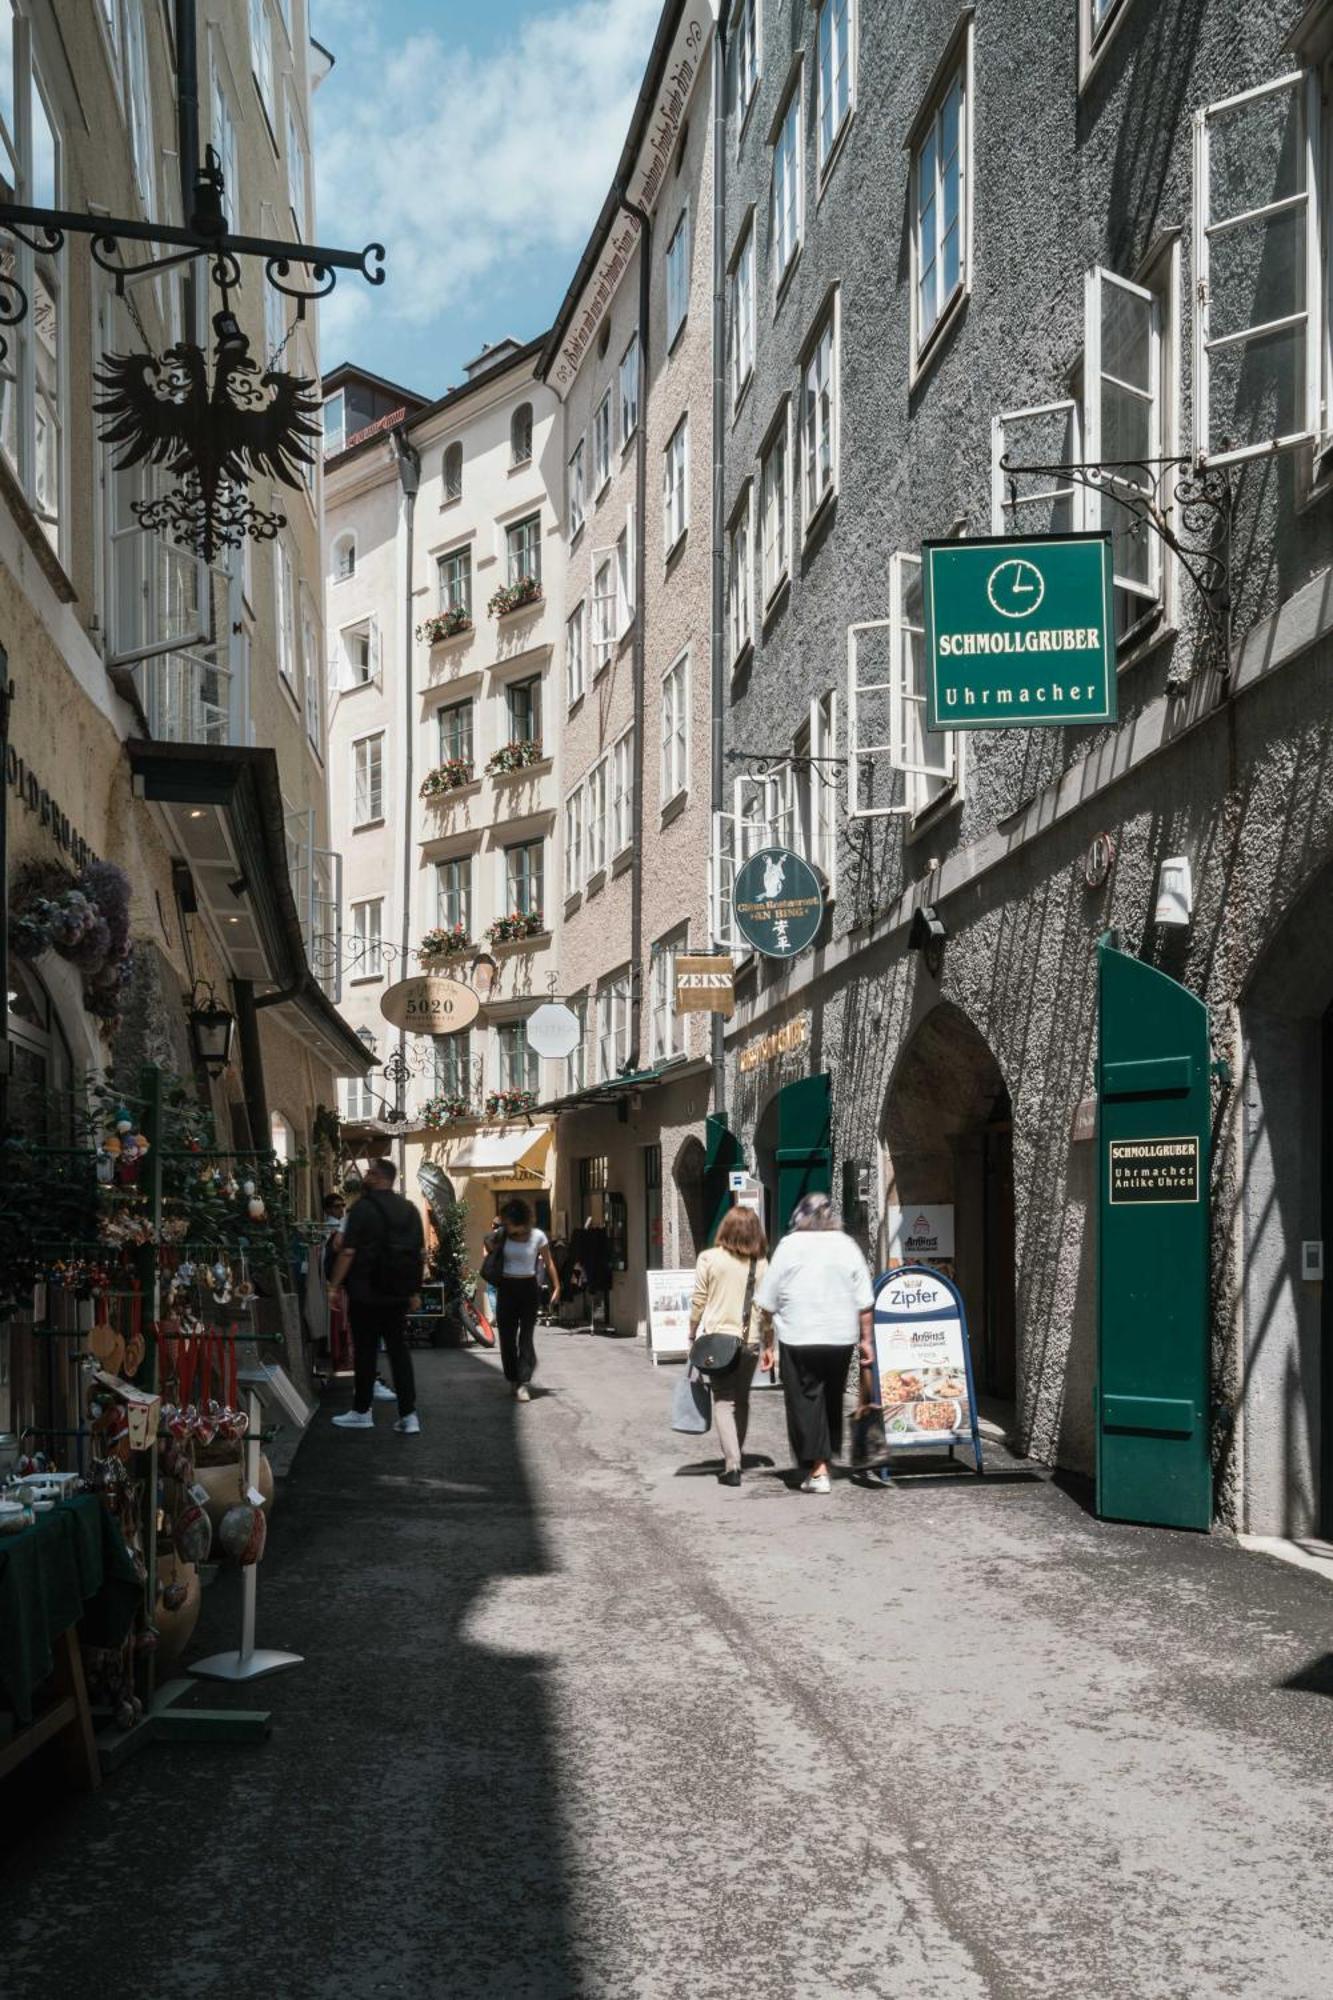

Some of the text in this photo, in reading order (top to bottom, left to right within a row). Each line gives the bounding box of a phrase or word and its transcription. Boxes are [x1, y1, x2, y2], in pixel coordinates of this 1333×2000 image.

[939, 628, 1101, 656] SCHMOLLGRUBER
[946, 683, 1096, 705] Uhrmacher
[677, 974, 733, 989] ZEISS
[405, 999, 454, 1014] 5020
[1112, 1143, 1196, 1158] SCHMOLLGRUBER
[1115, 1166, 1194, 1178] Uhrmacher
[1115, 1177, 1194, 1188] Antike Uhren
[891, 1289, 939, 1308] Zipfer
